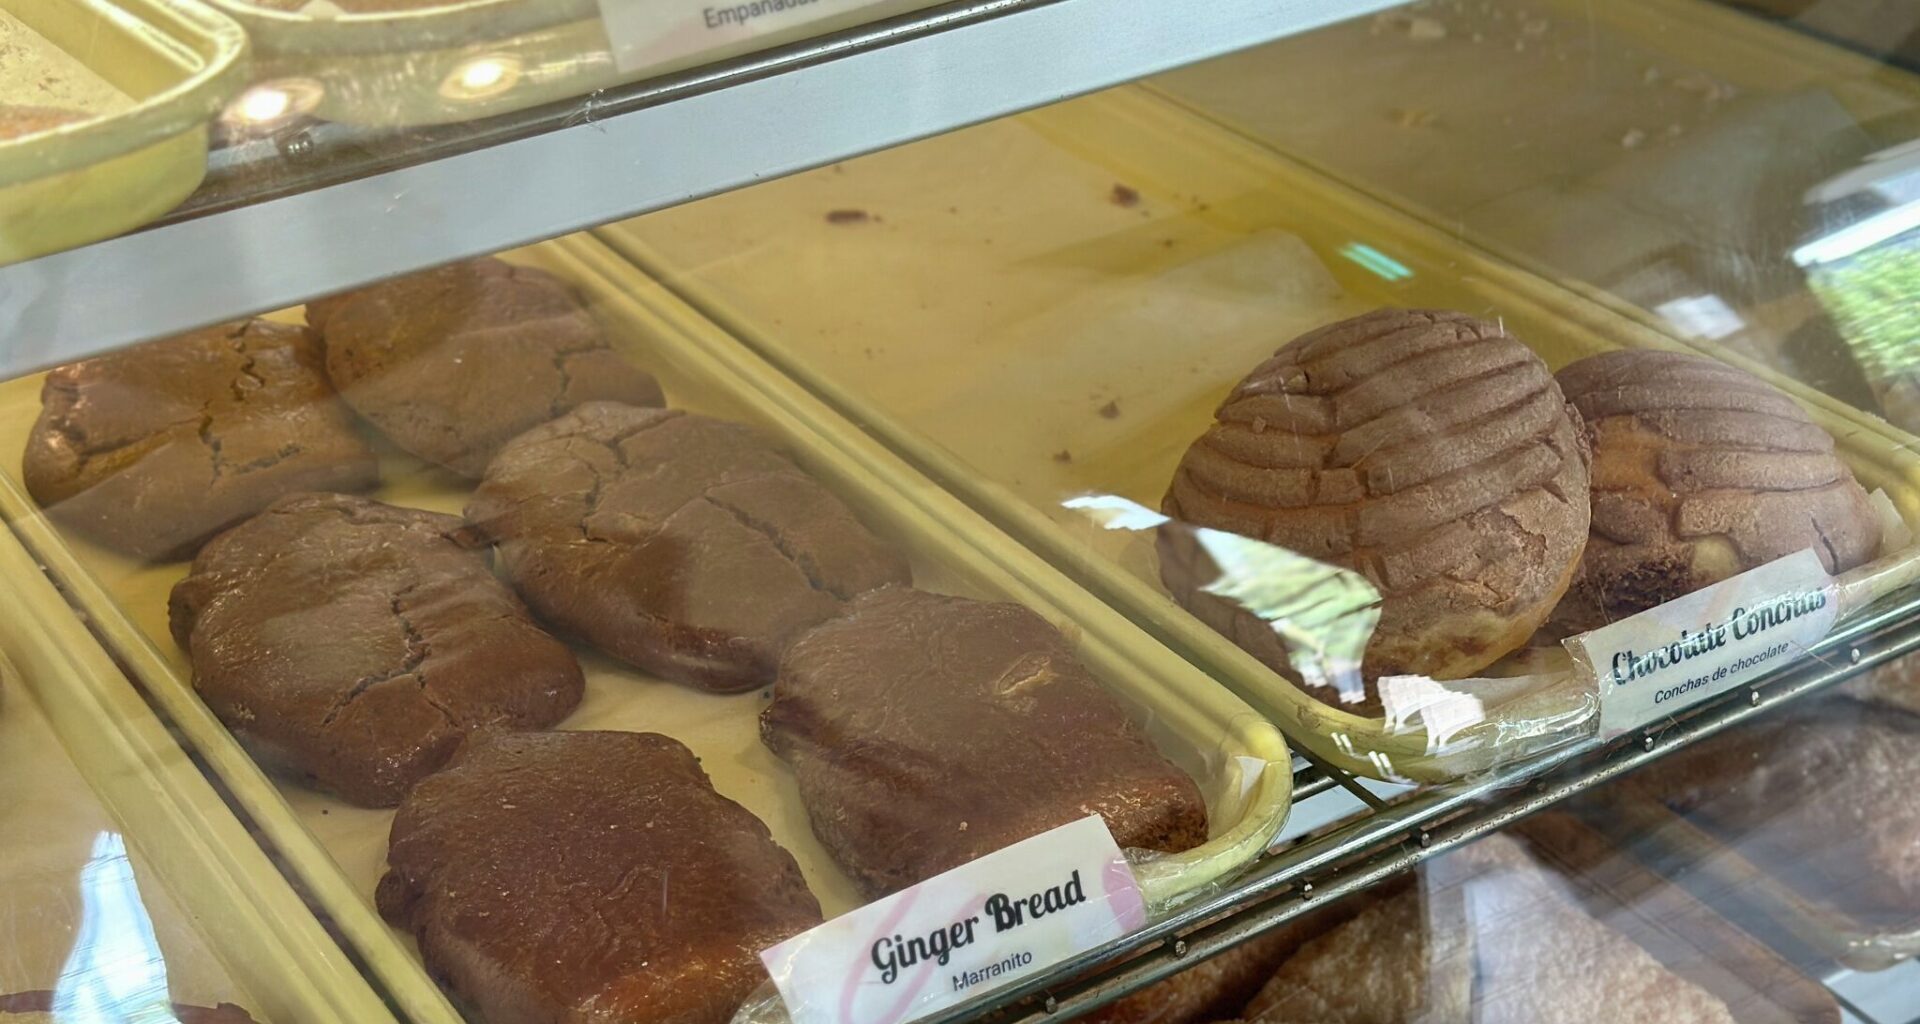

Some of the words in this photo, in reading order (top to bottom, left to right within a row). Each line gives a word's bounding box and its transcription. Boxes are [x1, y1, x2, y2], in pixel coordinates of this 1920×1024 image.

[1612, 622, 1727, 686] Chocolate
[1654, 674, 1709, 704] Conchas
[1712, 666, 1728, 682] de
[1730, 641, 1789, 675] chocolate
[870, 914, 979, 985] Ginger
[984, 869, 1087, 934] Bread
[951, 949, 1033, 992] Marranito
